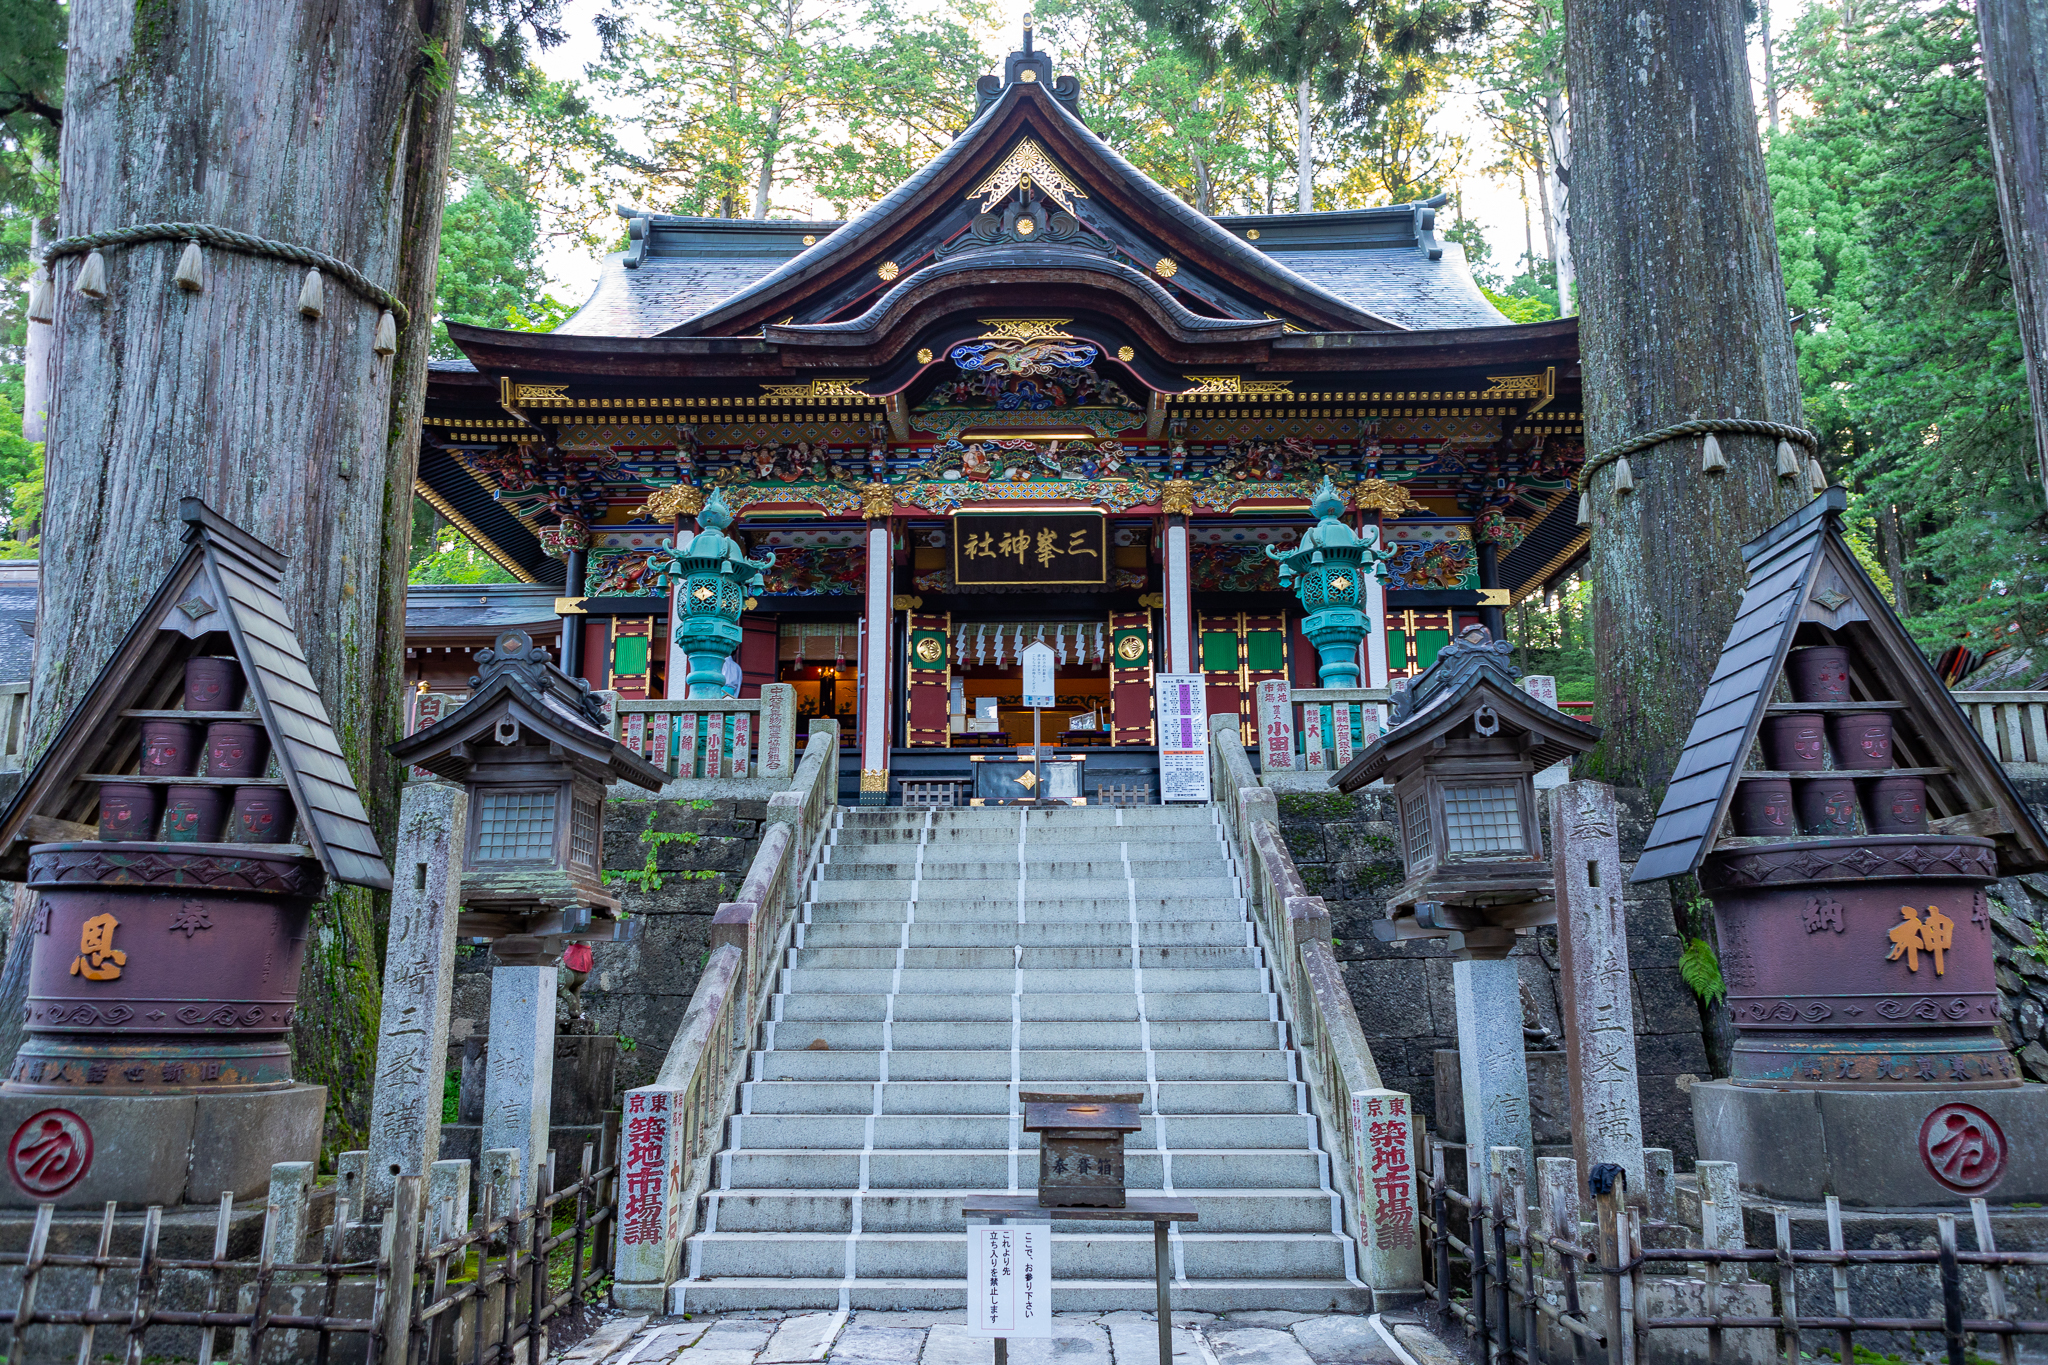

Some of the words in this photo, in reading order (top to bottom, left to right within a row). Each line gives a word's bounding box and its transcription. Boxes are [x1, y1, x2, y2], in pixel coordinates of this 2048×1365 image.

[963, 527, 1099, 568] 三峯神社
[170, 900, 213, 937] 奉
[1803, 896, 1845, 933] 納
[1885, 905, 1954, 976] 神
[70, 912, 127, 981] 恩
[629, 1093, 668, 1114] 東京
[1367, 1097, 1407, 1118] 東京
[623, 1116, 667, 1246] 築地市場講
[1369, 1120, 1416, 1251] 築地市場講
[989, 1231, 999, 1324] 立ち入りを禁止します
[1002, 1231, 1011, 1276] これより先
[1025, 1232, 1034, 1319] ここで、お参り下さい
